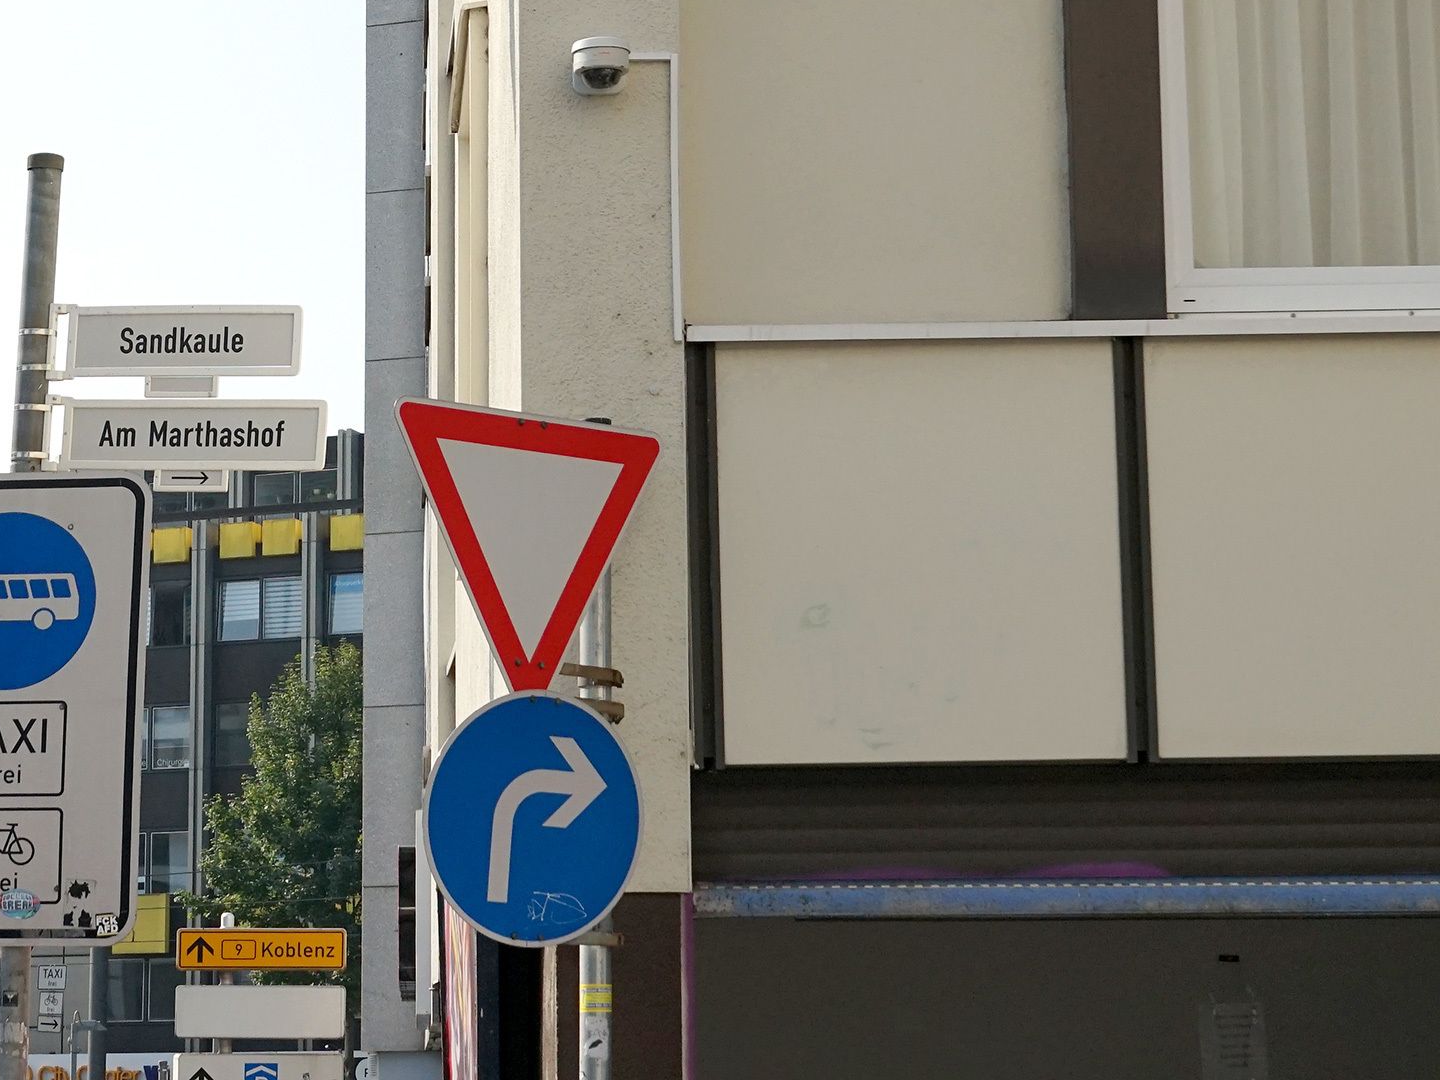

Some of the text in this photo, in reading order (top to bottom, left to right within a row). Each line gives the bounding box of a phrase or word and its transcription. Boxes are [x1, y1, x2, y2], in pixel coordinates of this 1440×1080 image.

[119, 326, 244, 354] Sandkaule
[98, 420, 285, 447] Am Marthashof
[96, 916, 118, 926] FCK
[235, 942, 335, 958] 9 Koblenz
[43, 968, 63, 979] TAXI
